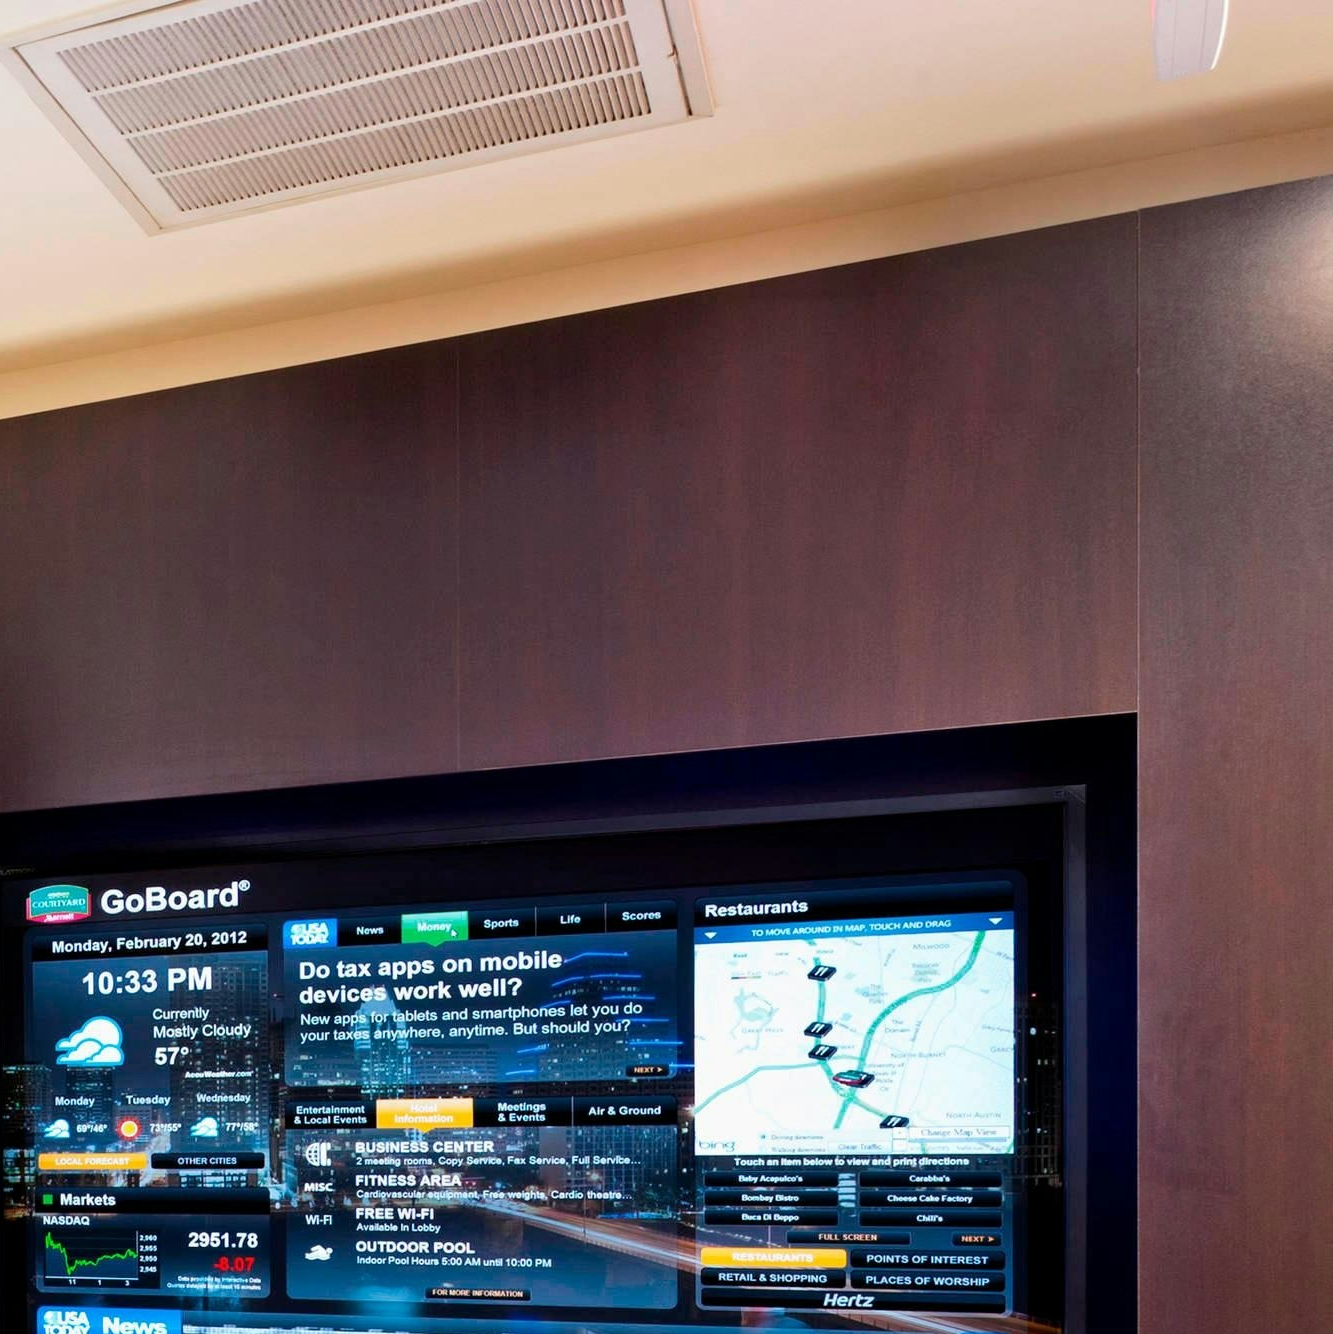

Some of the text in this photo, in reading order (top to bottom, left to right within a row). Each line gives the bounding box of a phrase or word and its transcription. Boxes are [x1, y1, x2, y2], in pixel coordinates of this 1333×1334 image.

[705, 900, 808, 918] Restaurants
[560, 914, 581, 924] Life
[622, 911, 662, 921] Scores
[417, 921, 451, 933] Money
[484, 917, 519, 930] Sports
[751, 929, 764, 937] TO
[765, 927, 791, 936] MOVE
[792, 925, 831, 935] AROUND
[833, 925, 843, 933] IN
[870, 922, 901, 932] TOUCH
[903, 921, 923, 930] AND
[925, 919, 952, 929] DRAG
[356, 926, 384, 936] News
[51, 931, 247, 955] Monday, February 20, 2012
[299, 950, 563, 980] Do tax apps on mobile
[81, 966, 212, 995] 10:33 PM
[299, 977, 523, 1004] devices work well?
[152, 1007, 210, 1022] Currently
[300, 1002, 643, 1027] New apps for tablets and smartphones let you do
[153, 1022, 252, 1040] Mostly Cloudy
[300, 1019, 631, 1045] your taxes anywhere, anytime. But should you?
[154, 1046, 189, 1066] 57°
[55, 1096, 95, 1108] Monday
[126, 1094, 171, 1107] Tuesday
[196, 1092, 251, 1104] Wednesday
[296, 1105, 365, 1115] Entertainment
[410, 1103, 437, 1113] Hotel
[497, 1102, 547, 1113] Meetings
[588, 1105, 661, 1116] Air & Ground
[294, 1115, 367, 1125] & Local Events
[394, 1113, 453, 1124] Information
[497, 1112, 546, 1122] & Events
[355, 1141, 494, 1154] BUSINESS CENTER
[55, 1156, 130, 1166] LOCAL FORECAST
[177, 1157, 237, 1166] OTHER CITIES
[734, 1158, 765, 1166] Touch
[803, 1158, 833, 1166] below
[834, 1157, 844, 1166] to
[847, 1157, 870, 1166] view
[871, 1157, 891, 1166] and
[893, 1157, 917, 1167] print
[919, 1157, 970, 1166] directions
[304, 1182, 333, 1192] MISC
[355, 1175, 462, 1187] FITNESS AREA
[60, 1193, 116, 1207] Markets
[887, 1194, 973, 1204] Cheese Cake Factory
[355, 1207, 434, 1220] FREE WI-FI
[43, 1215, 90, 1227] NASDAQ
[356, 1222, 442, 1234] Available In Lobby
[188, 1232, 259, 1249] 2951.78
[818, 1233, 878, 1242] FULL SCREEN
[961, 1235, 984, 1243] NEXT
[355, 1241, 475, 1255] OUTDOOR POOL
[356, 1256, 552, 1268] Indoor Pool Hours 5:00 AM until 10:00 PM
[731, 1251, 814, 1263] RESTAURANTS
[866, 1253, 989, 1265] POINTS OF INTEREST
[214, 1257, 255, 1273] -8.07
[718, 1272, 827, 1284] RETAIL & SHOPPING
[865, 1275, 990, 1288] PLACES OF WORSHIP
[823, 1293, 875, 1308] Hertz
